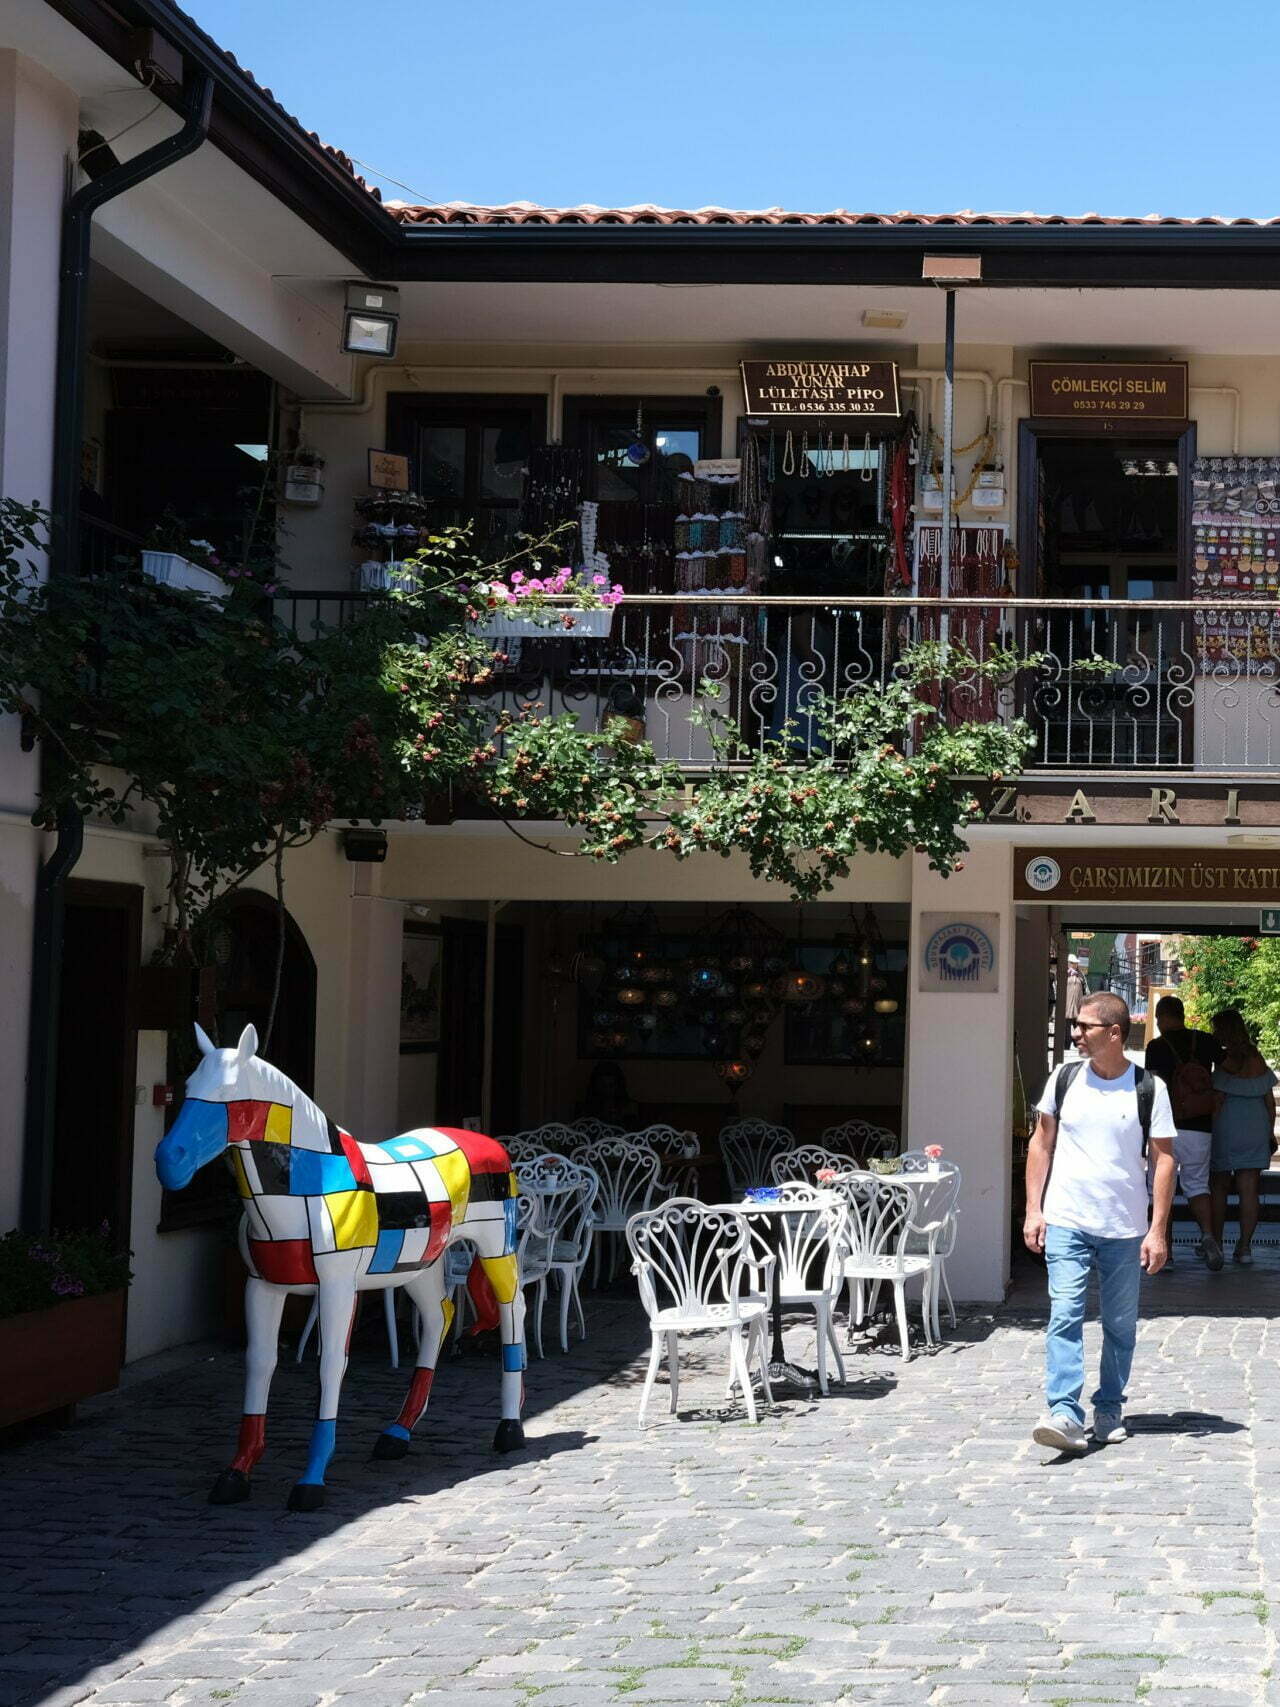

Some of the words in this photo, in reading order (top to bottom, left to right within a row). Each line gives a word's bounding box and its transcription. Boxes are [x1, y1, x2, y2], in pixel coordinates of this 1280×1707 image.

[791, 375, 846, 388] YUNAR
[1051, 377, 1122, 396] ÇÖMLEKÇİ
[1126, 378, 1167, 394] SELİM
[759, 386, 834, 401] LÜLETAŞI
[847, 387, 884, 400] PİPO
[799, 403, 825, 412] 0536
[828, 403, 846, 412] 335
[849, 403, 861, 412] 30
[864, 402, 875, 412] 32
[1073, 400, 1097, 410] 0533
[1100, 401, 1117, 410] 745
[1070, 867, 1187, 894] ÇARŞIMIZIN
[1190, 863, 1230, 890] ÜST
